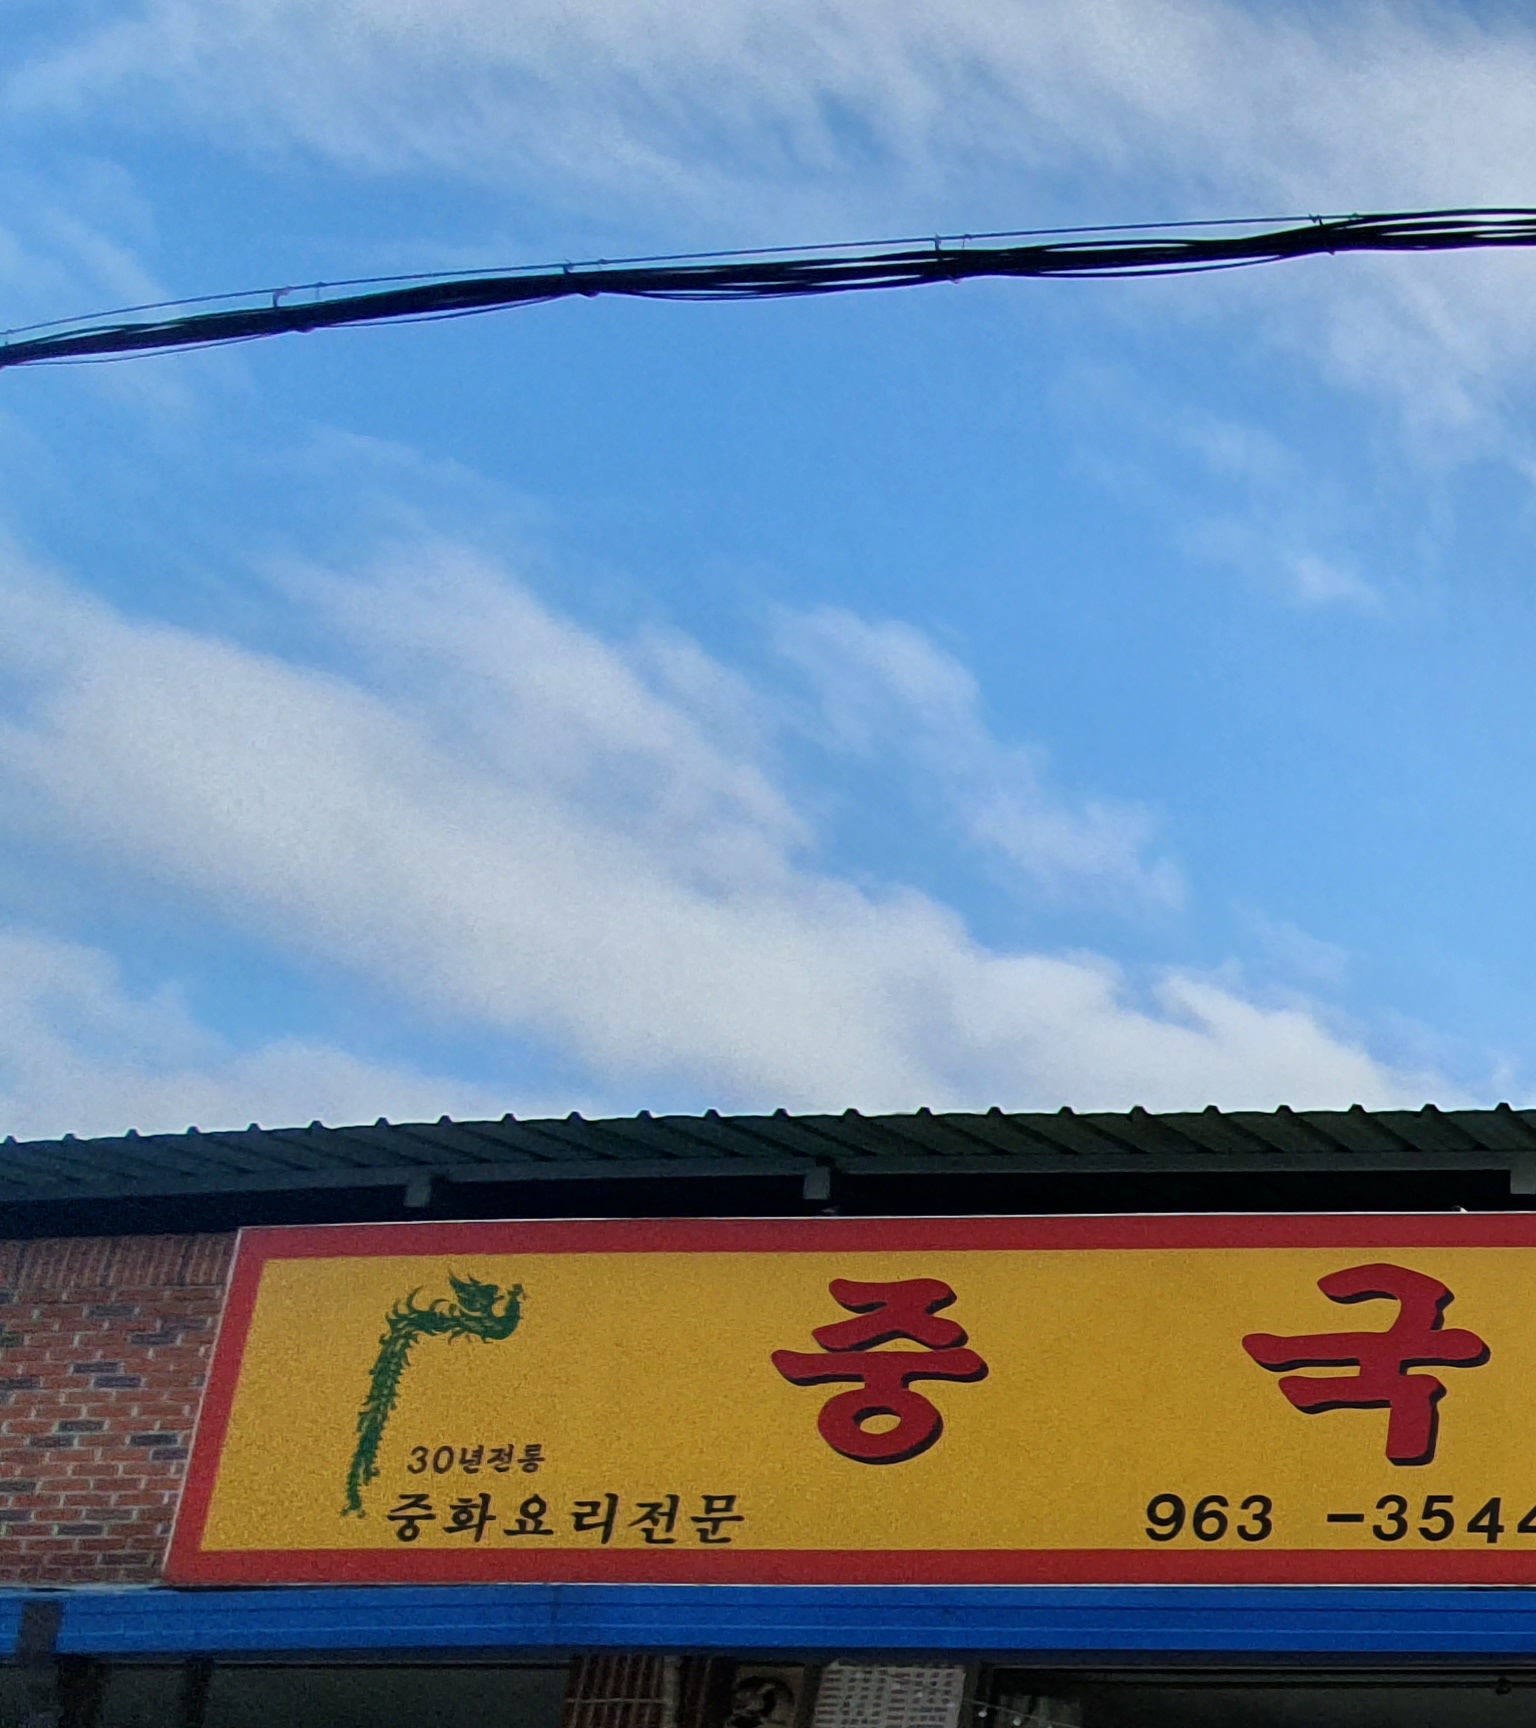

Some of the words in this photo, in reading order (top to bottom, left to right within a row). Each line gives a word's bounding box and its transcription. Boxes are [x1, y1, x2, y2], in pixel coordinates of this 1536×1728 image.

[407, 1444, 546, 1475] 30년전통
[385, 1493, 745, 1545] 중화요리전문
[1144, 1492, 1274, 1543] 963
